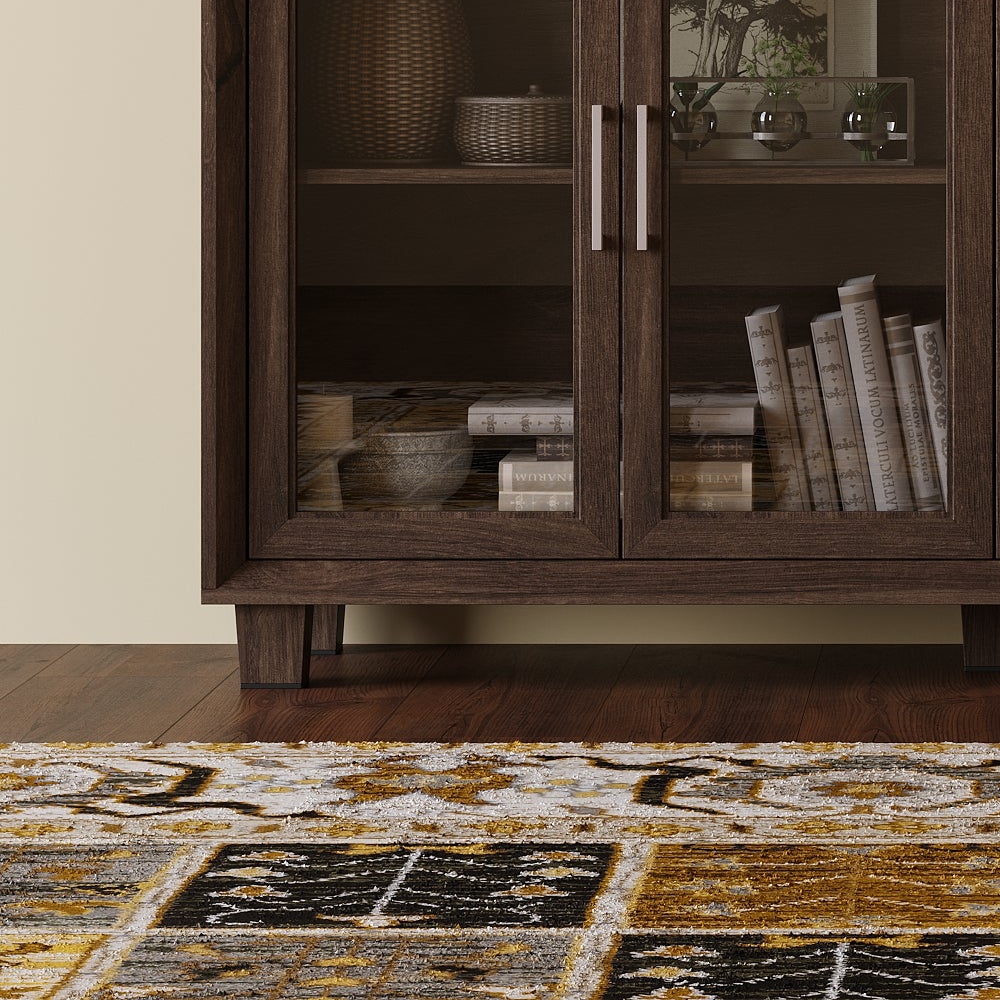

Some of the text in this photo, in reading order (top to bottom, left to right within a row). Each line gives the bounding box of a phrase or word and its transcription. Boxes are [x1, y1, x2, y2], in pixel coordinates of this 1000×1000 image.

[854, 303, 899, 512] LATERCULI VOCUM LATINARUM
